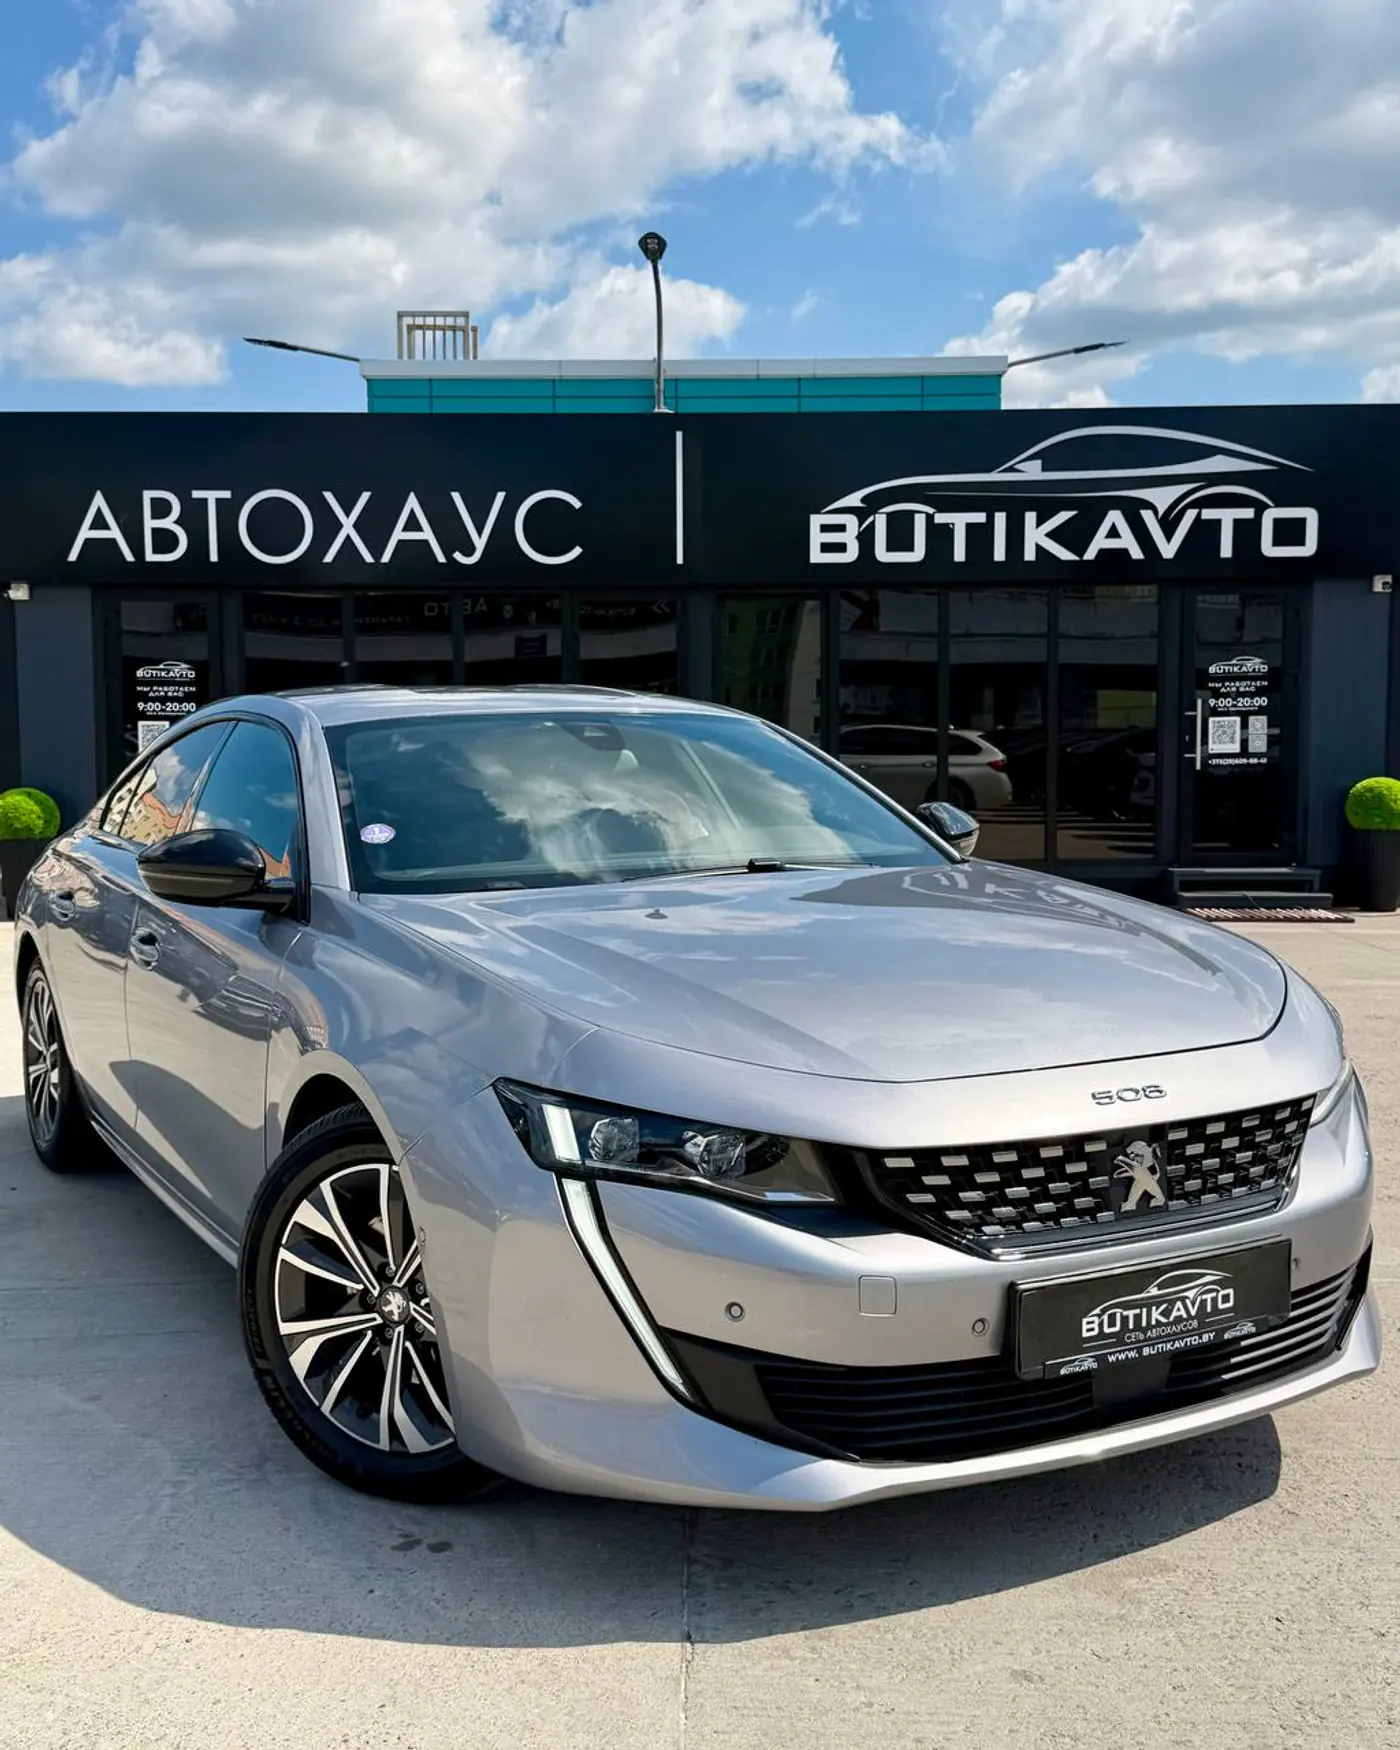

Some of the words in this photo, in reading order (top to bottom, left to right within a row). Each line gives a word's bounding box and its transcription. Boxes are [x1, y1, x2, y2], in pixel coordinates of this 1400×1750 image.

[67, 488, 584, 566] АВТОХАУС
[808, 506, 1320, 565] BUTIKAVTO
[1208, 665, 1268, 673] BUTIKAVTO
[137, 702, 196, 711] 9:00-20:00
[1208, 697, 1268, 707] 9:00-20:00
[1082, 1288, 1235, 1338] BUTIKAVTO
[1123, 1331, 1144, 1343] СЕТЬ
[1145, 1319, 1200, 1339] АВТОХАУСОВ
[1142, 1331, 1216, 1357] BUTIKAVTO.BY
